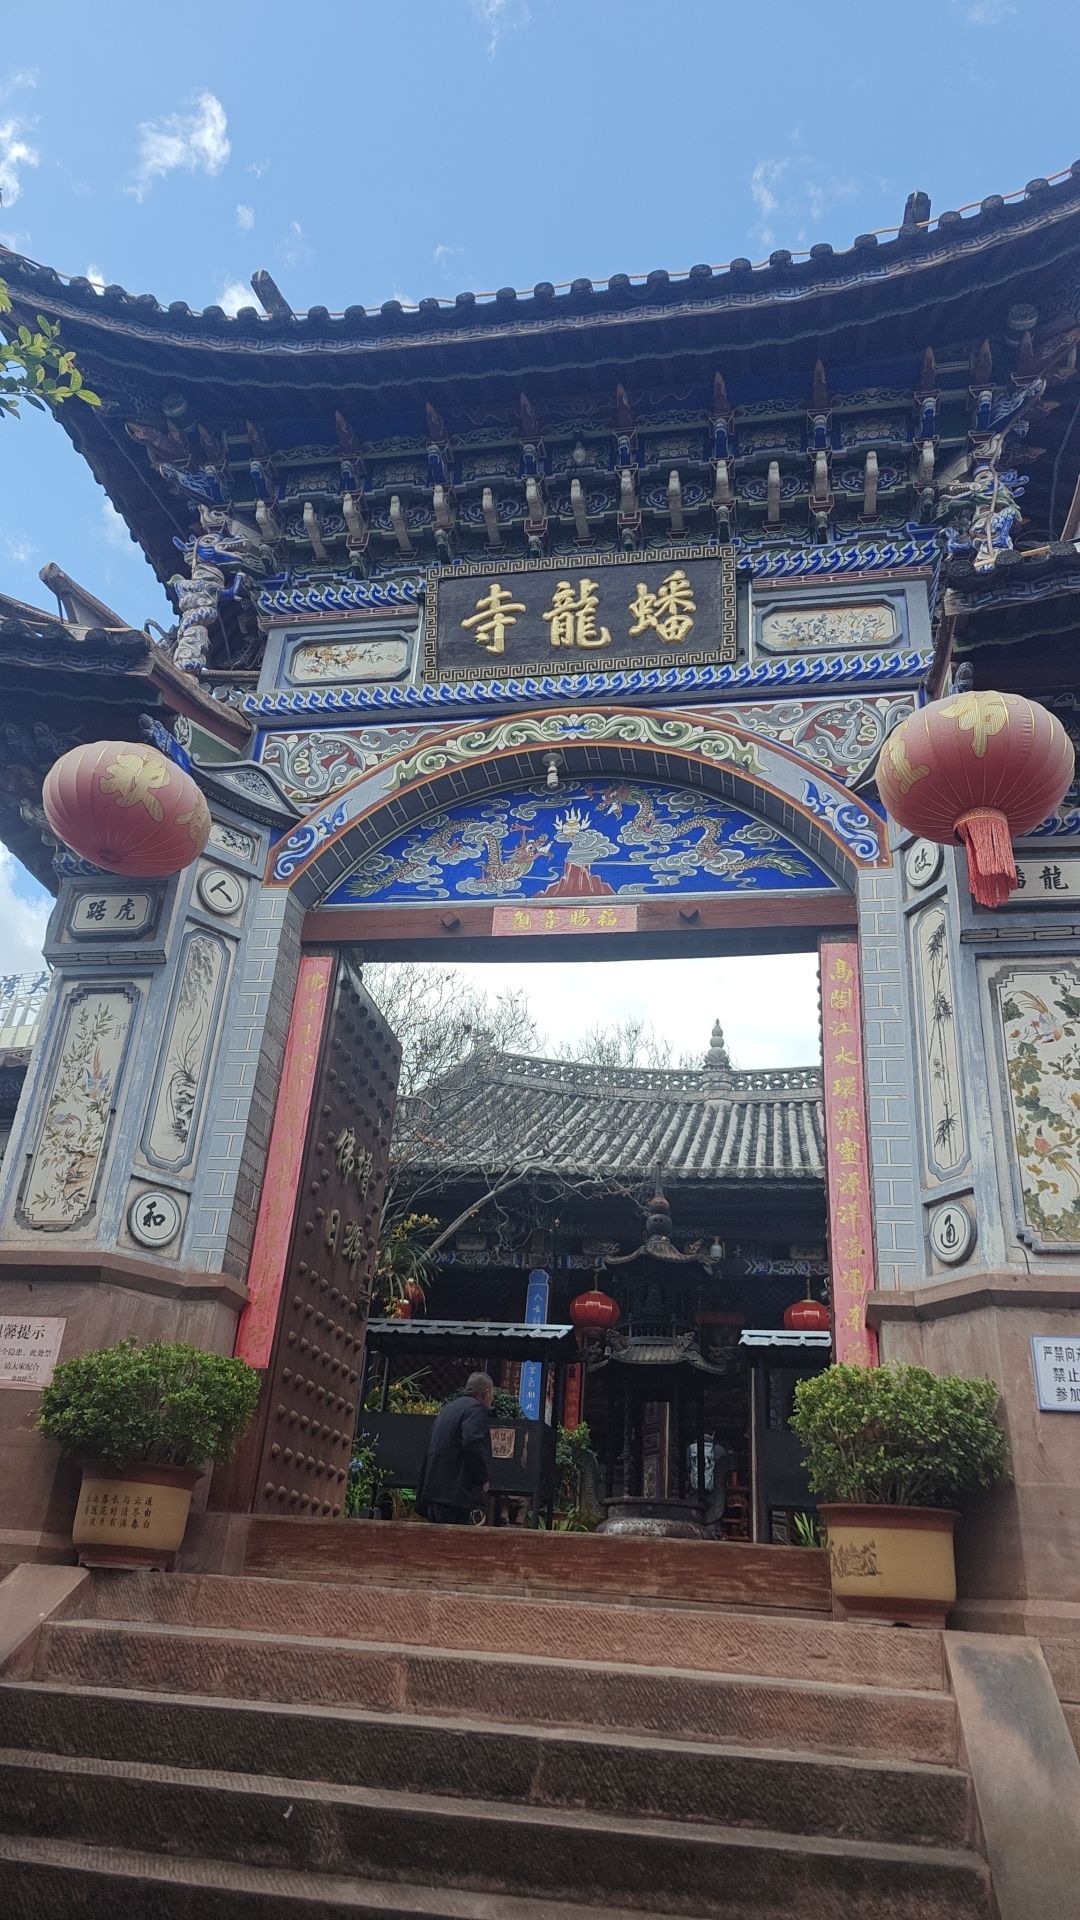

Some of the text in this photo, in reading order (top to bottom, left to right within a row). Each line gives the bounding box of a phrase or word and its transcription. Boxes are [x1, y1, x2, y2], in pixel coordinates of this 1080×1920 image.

[142, 1200, 166, 1227] 和
[0, 1323, 46, 1340] 馨提示
[1052, 1367, 1080, 1383] 禁止
